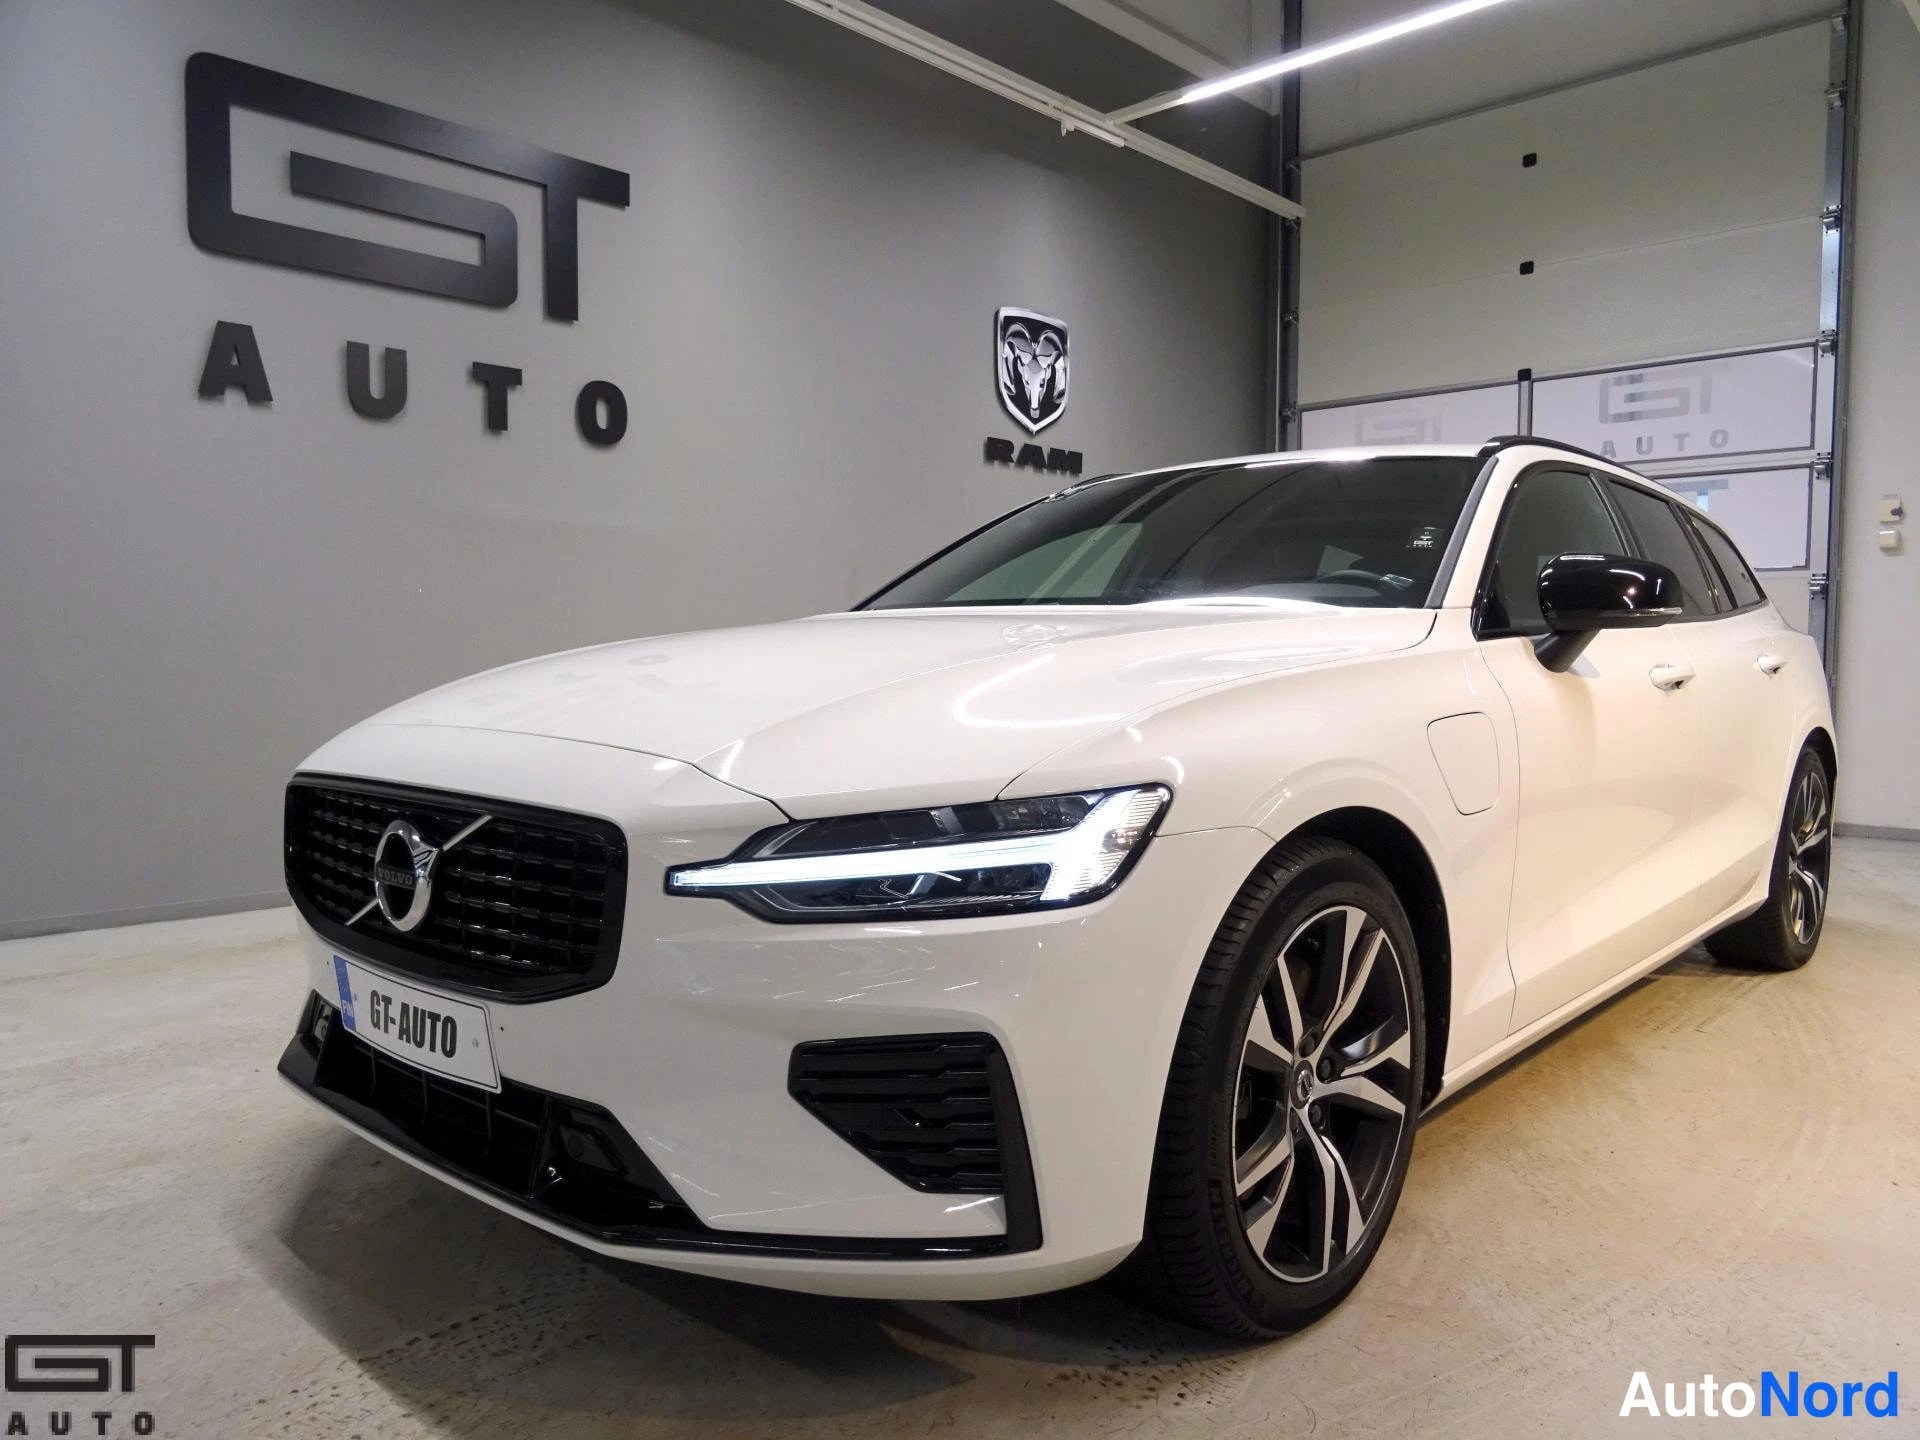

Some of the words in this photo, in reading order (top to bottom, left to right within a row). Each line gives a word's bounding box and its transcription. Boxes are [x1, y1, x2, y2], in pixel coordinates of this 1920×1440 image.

[185, 52, 630, 322] GT
[199, 320, 628, 446] AUTO
[985, 436, 1083, 474] RAM
[1601, 429, 1729, 458] AUTO
[377, 867, 413, 885] VOLVO
[370, 989, 457, 1058] GT-AUTO
